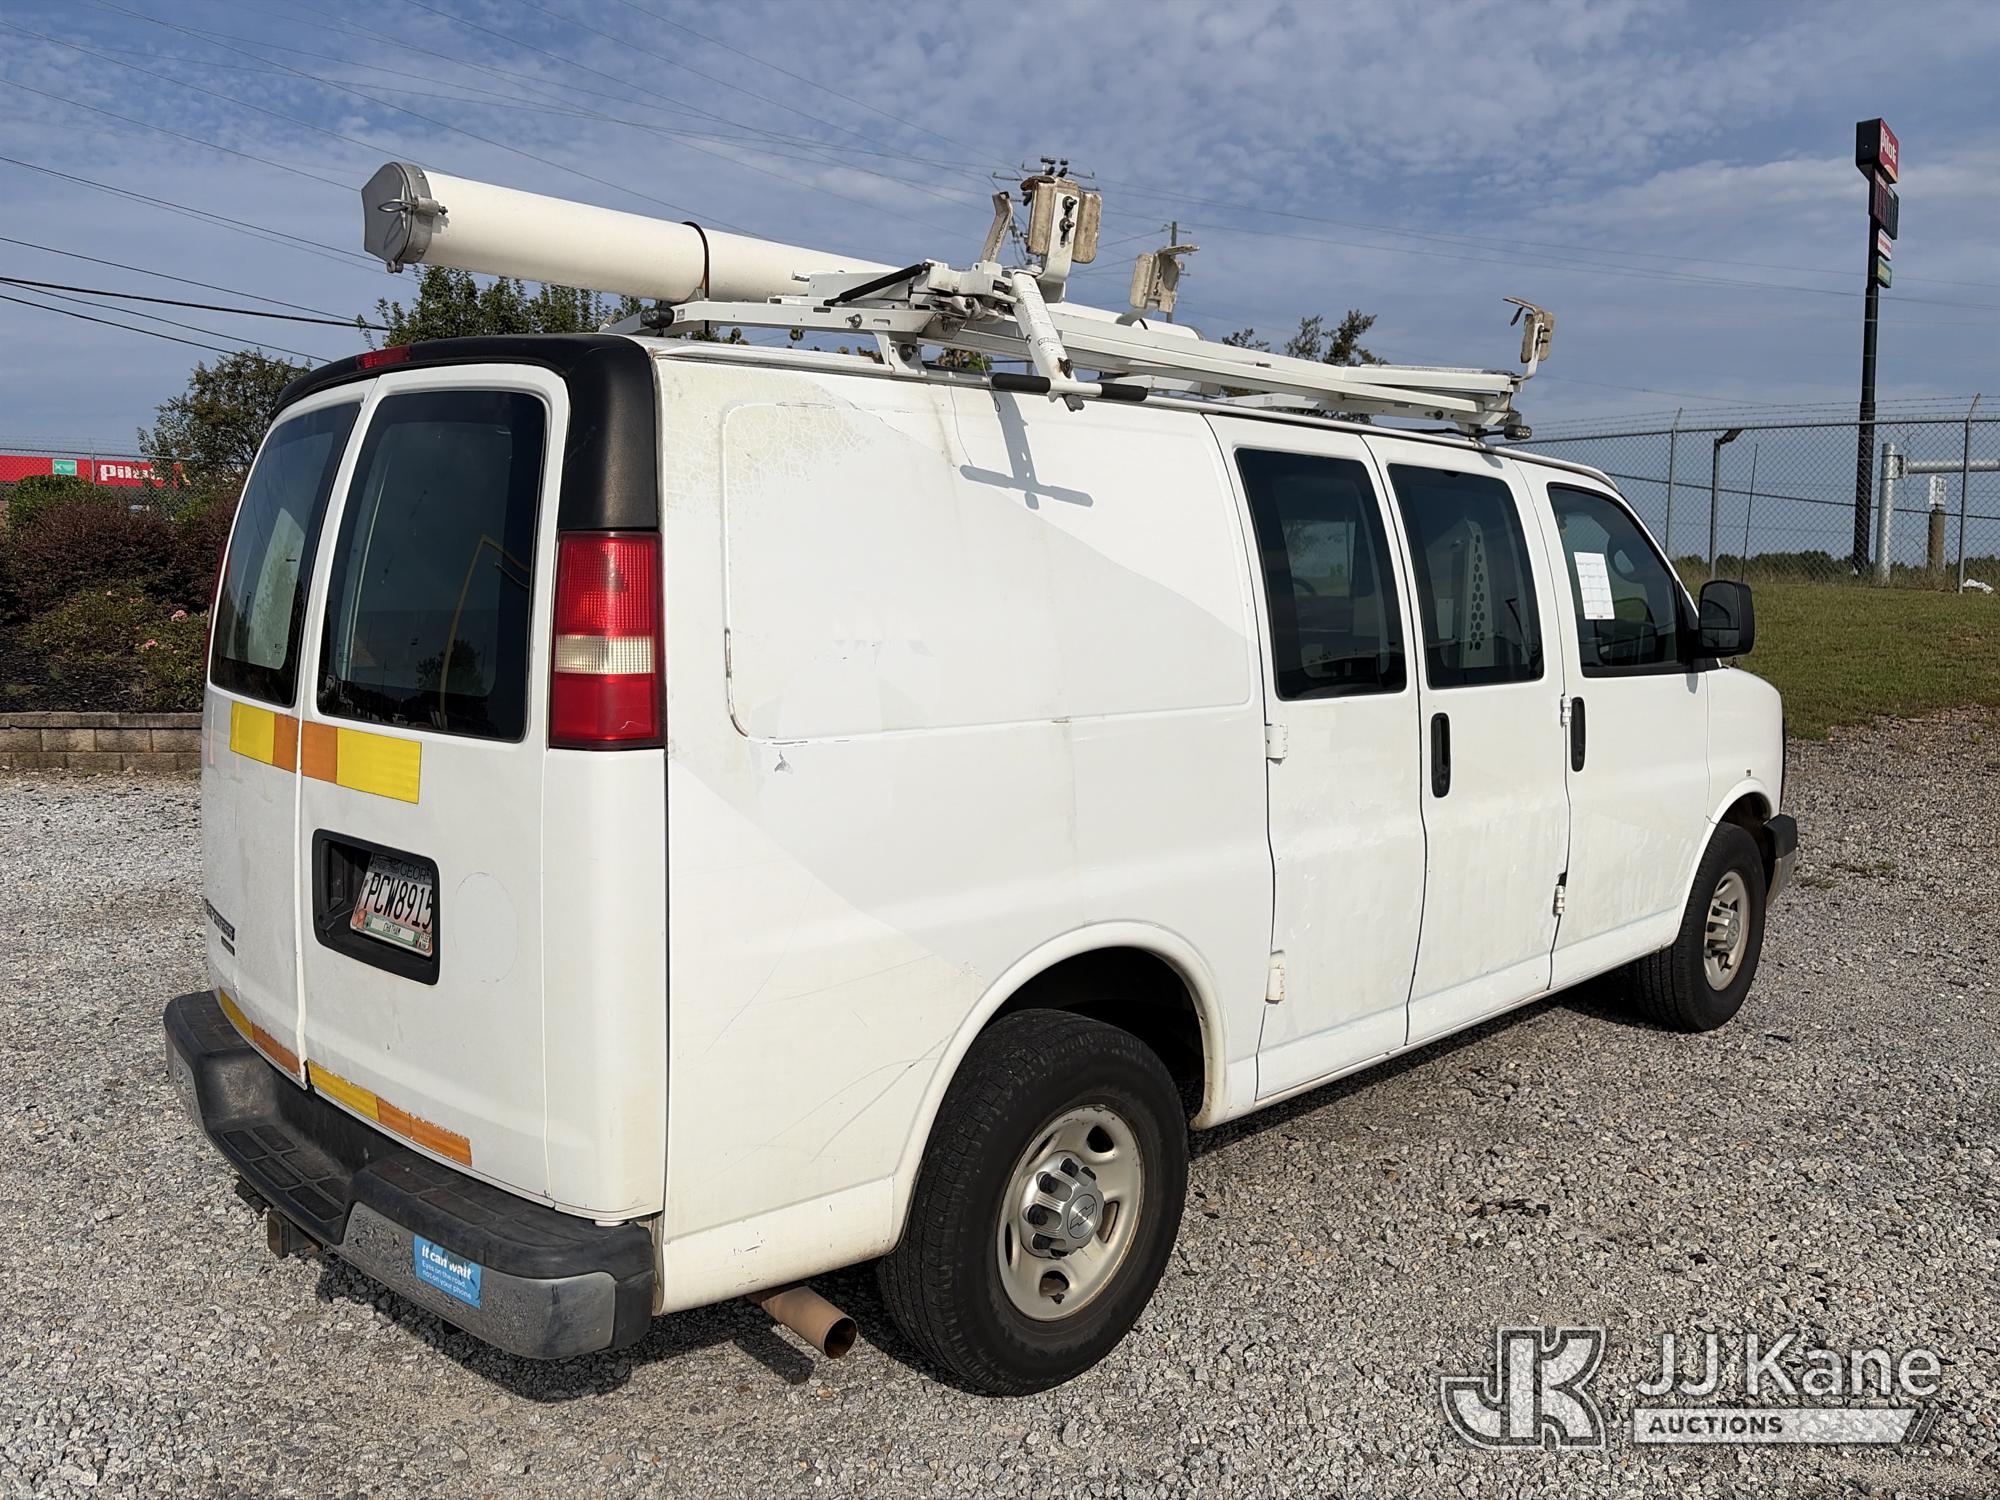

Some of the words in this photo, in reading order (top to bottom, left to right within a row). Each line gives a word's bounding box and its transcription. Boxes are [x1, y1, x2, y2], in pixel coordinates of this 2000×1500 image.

[1880, 126, 1897, 165] Pilot
[364, 872, 432, 929] PCW8915
[430, 1252, 447, 1268] can
[449, 1261, 472, 1280] wait
